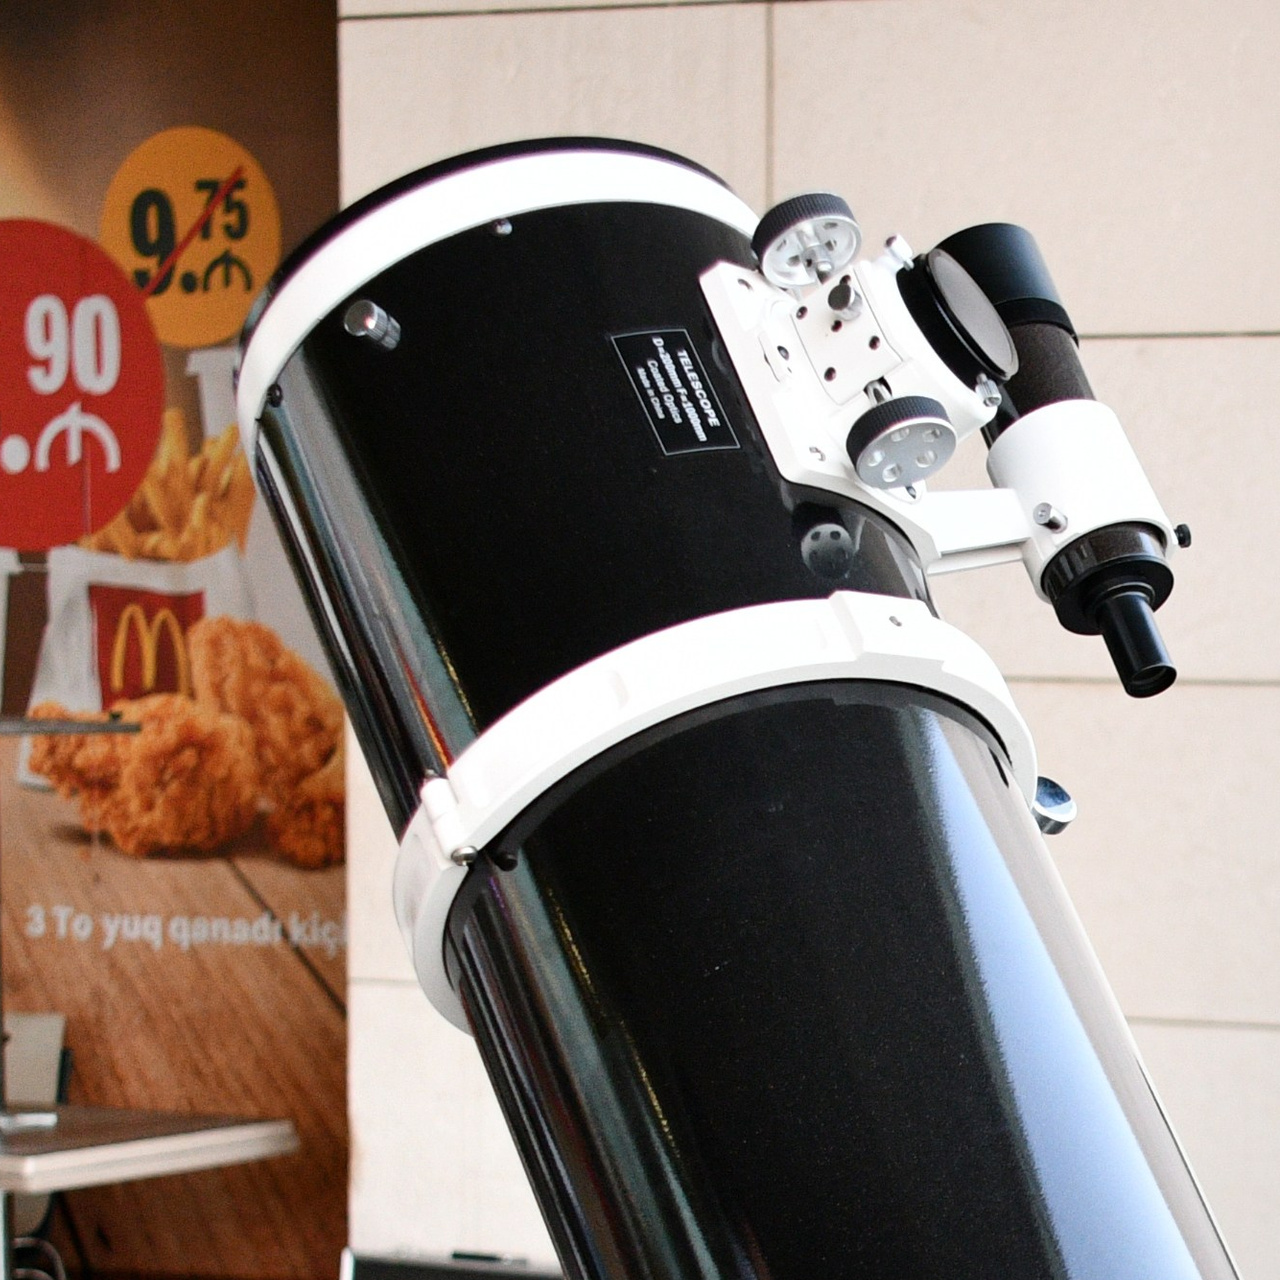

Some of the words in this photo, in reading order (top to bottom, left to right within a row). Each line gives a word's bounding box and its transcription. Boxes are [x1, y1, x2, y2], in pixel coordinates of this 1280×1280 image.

[647, 358, 670, 393] Coated
[663, 392, 683, 424] Optics
[651, 395, 665, 419] China
[677, 349, 720, 427] TELESCOPE
[26, 905, 46, 938] 3
